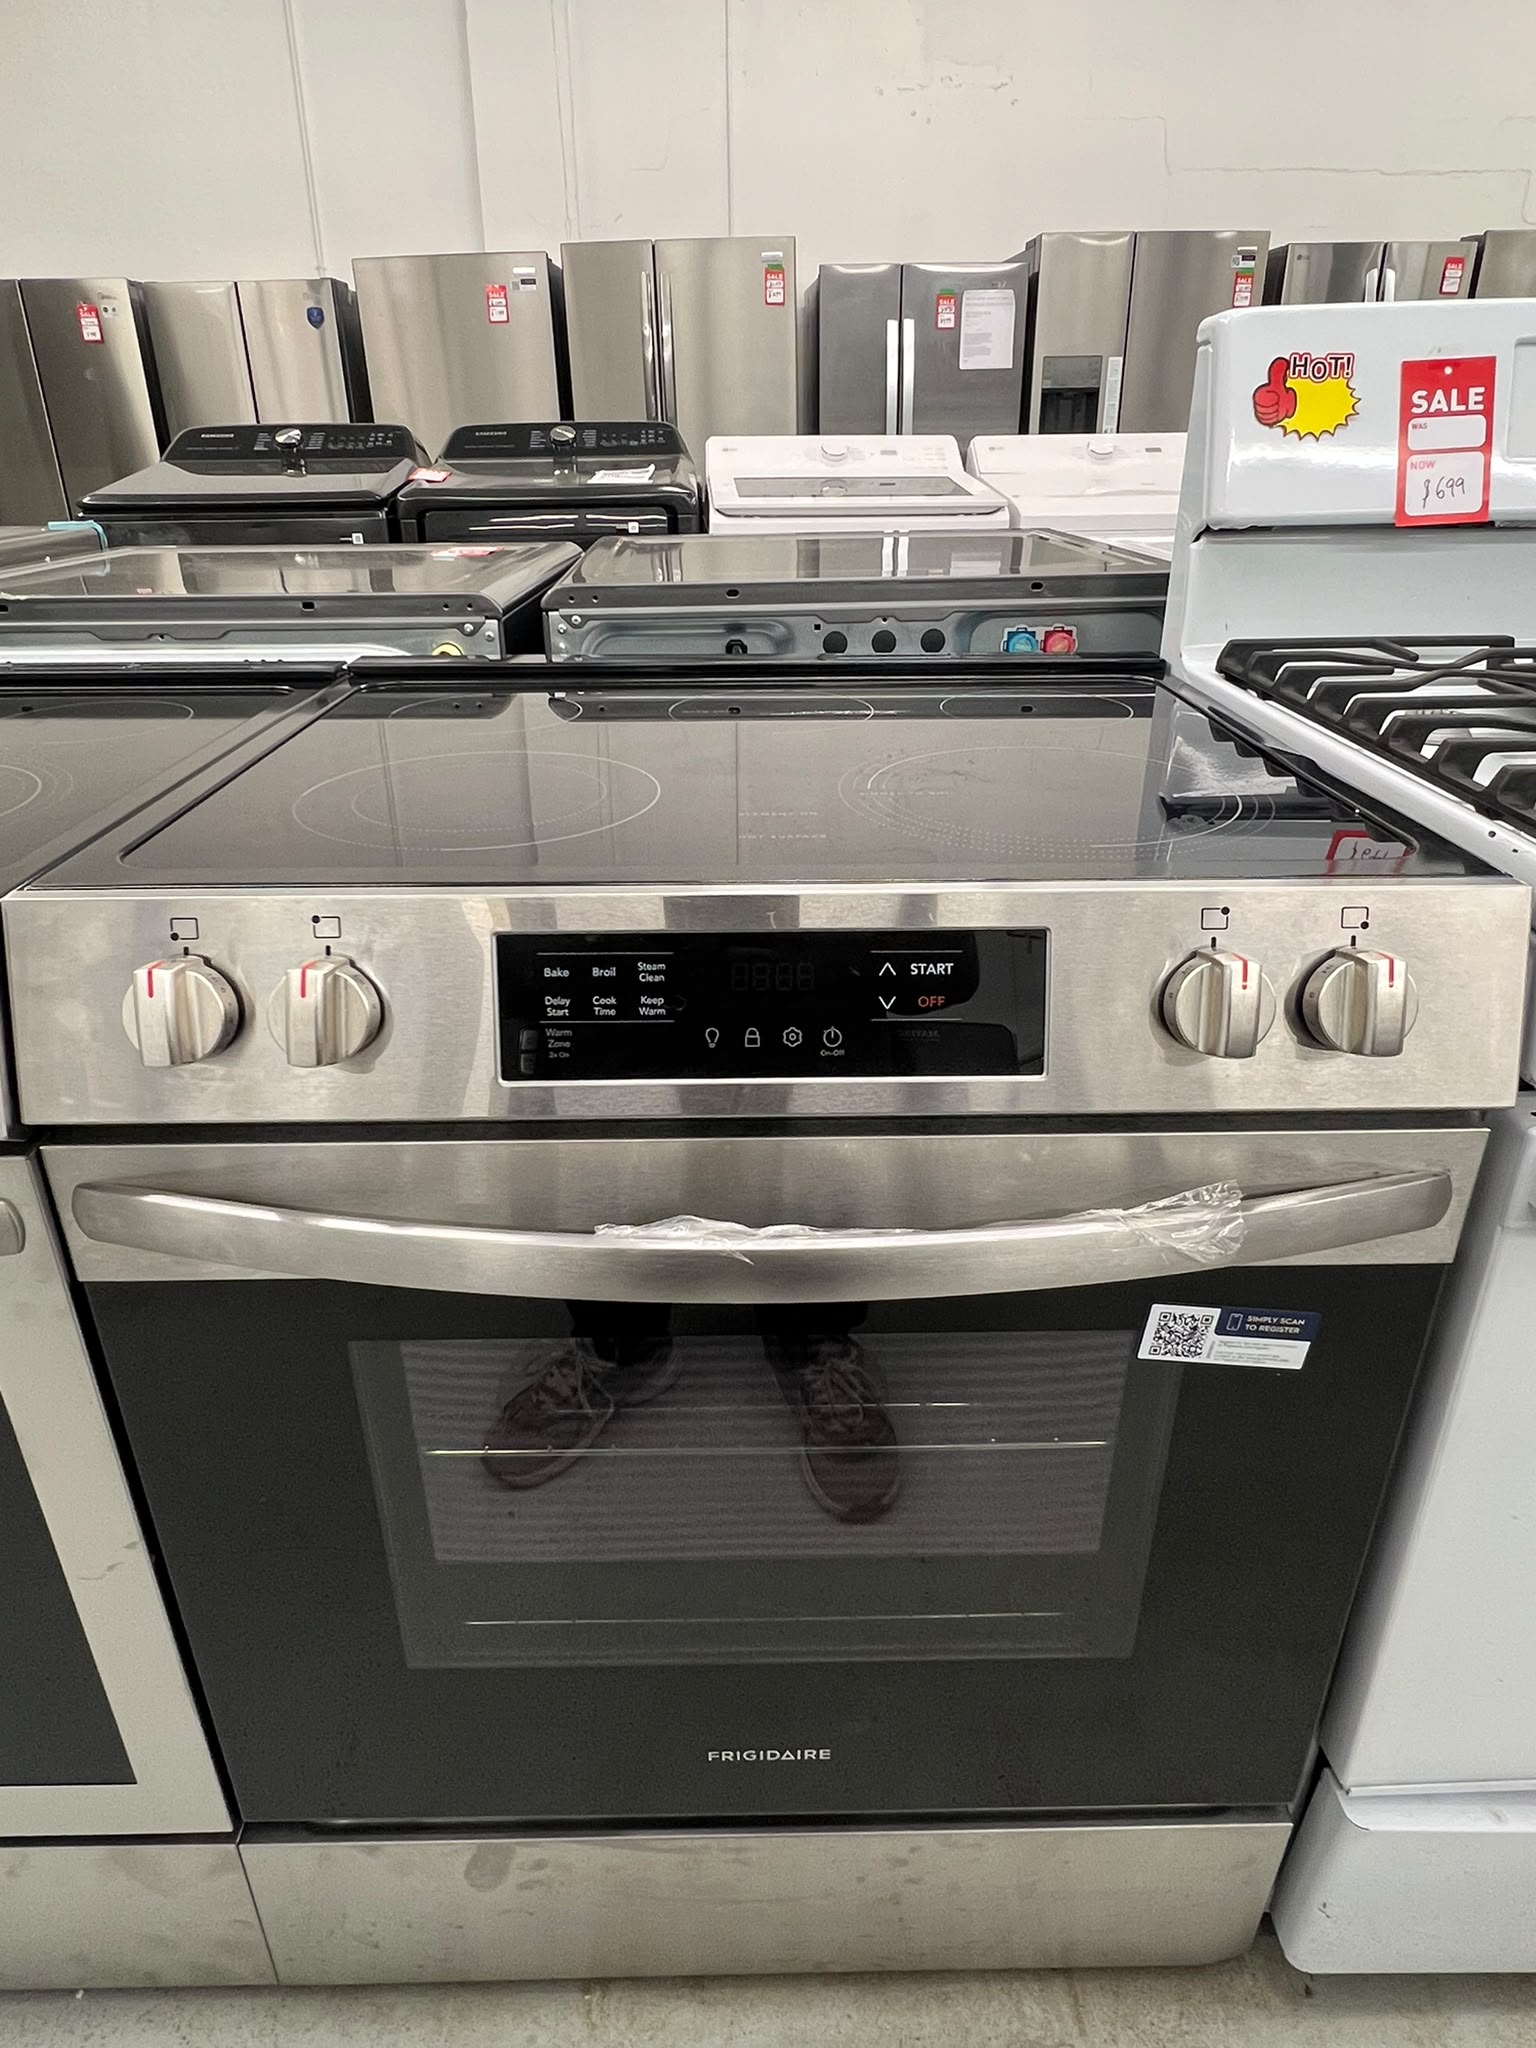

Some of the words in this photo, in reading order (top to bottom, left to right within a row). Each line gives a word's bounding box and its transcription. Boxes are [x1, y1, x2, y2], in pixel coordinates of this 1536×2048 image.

[1410, 387, 1485, 414] SALE
[1410, 460, 1436, 470] NOW
[637, 962, 666, 971] Steam
[910, 963, 954, 975] START
[544, 967, 570, 977] Bake
[592, 967, 617, 977] Broil
[639, 973, 665, 982] Clean
[544, 996, 571, 1007] Delay
[592, 995, 617, 1005] Cook
[640, 995, 665, 1006] Keep
[918, 996, 945, 1007] OFF
[546, 1007, 570, 1016] Start
[593, 1007, 617, 1015] Time
[638, 1007, 666, 1015] Warm
[545, 1028, 573, 1037] Warm
[547, 1039, 571, 1048] Zone
[1246, 1315, 1277, 1324] SIMPLY
[1279, 1317, 1305, 1325] SCAN
[1258, 1325, 1300, 1334] REGISTER
[707, 1749, 831, 1761] FRIGIDAIRE
